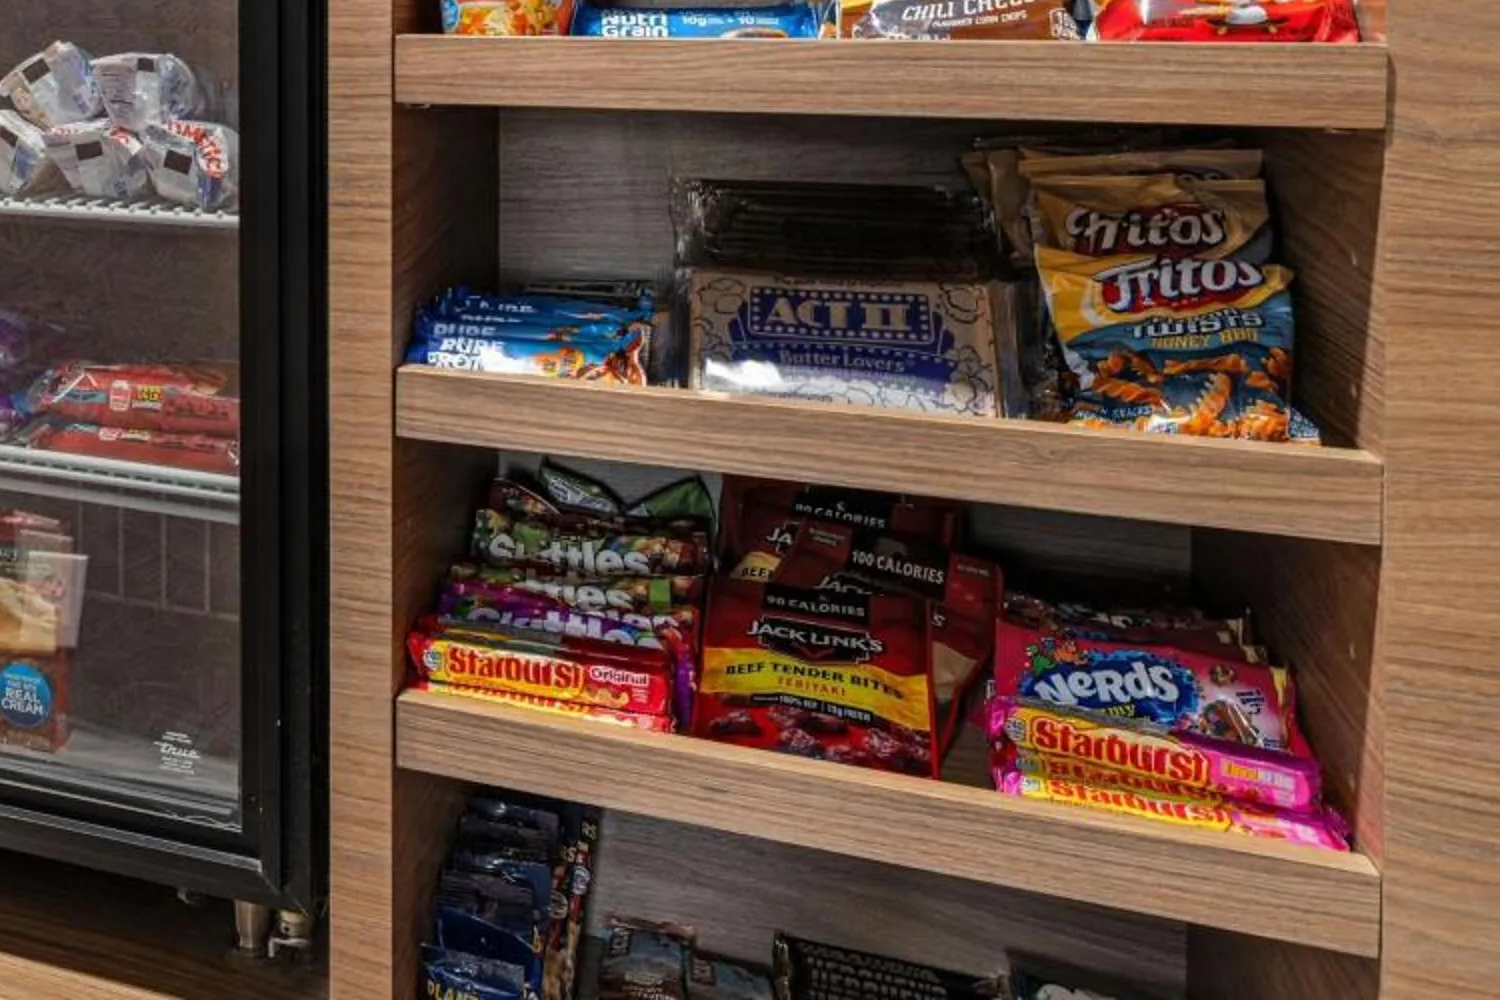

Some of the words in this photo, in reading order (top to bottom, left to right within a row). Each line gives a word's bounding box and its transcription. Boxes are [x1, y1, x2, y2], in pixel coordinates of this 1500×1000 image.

[902, 1, 954, 22] CHILI
[1094, 257, 1263, 313] Fritos
[767, 298, 853, 329] ACT
[859, 302, 913, 331] II
[781, 350, 841, 367] Butter
[844, 353, 906, 373] Lovers
[852, 549, 875, 568] 100
[876, 554, 946, 586] CALORIES
[787, 597, 866, 618] CALORIES
[747, 619, 806, 644] JACK
[449, 647, 584, 690] Starburst
[590, 667, 648, 686] Original
[725, 661, 764, 677] BEEF
[770, 662, 846, 685] TENDER
[850, 673, 906, 699] BITES
[1, 698, 44, 715] CREAM
[4, 687, 41, 704] REAL
[1035, 718, 1208, 786] Starburst
